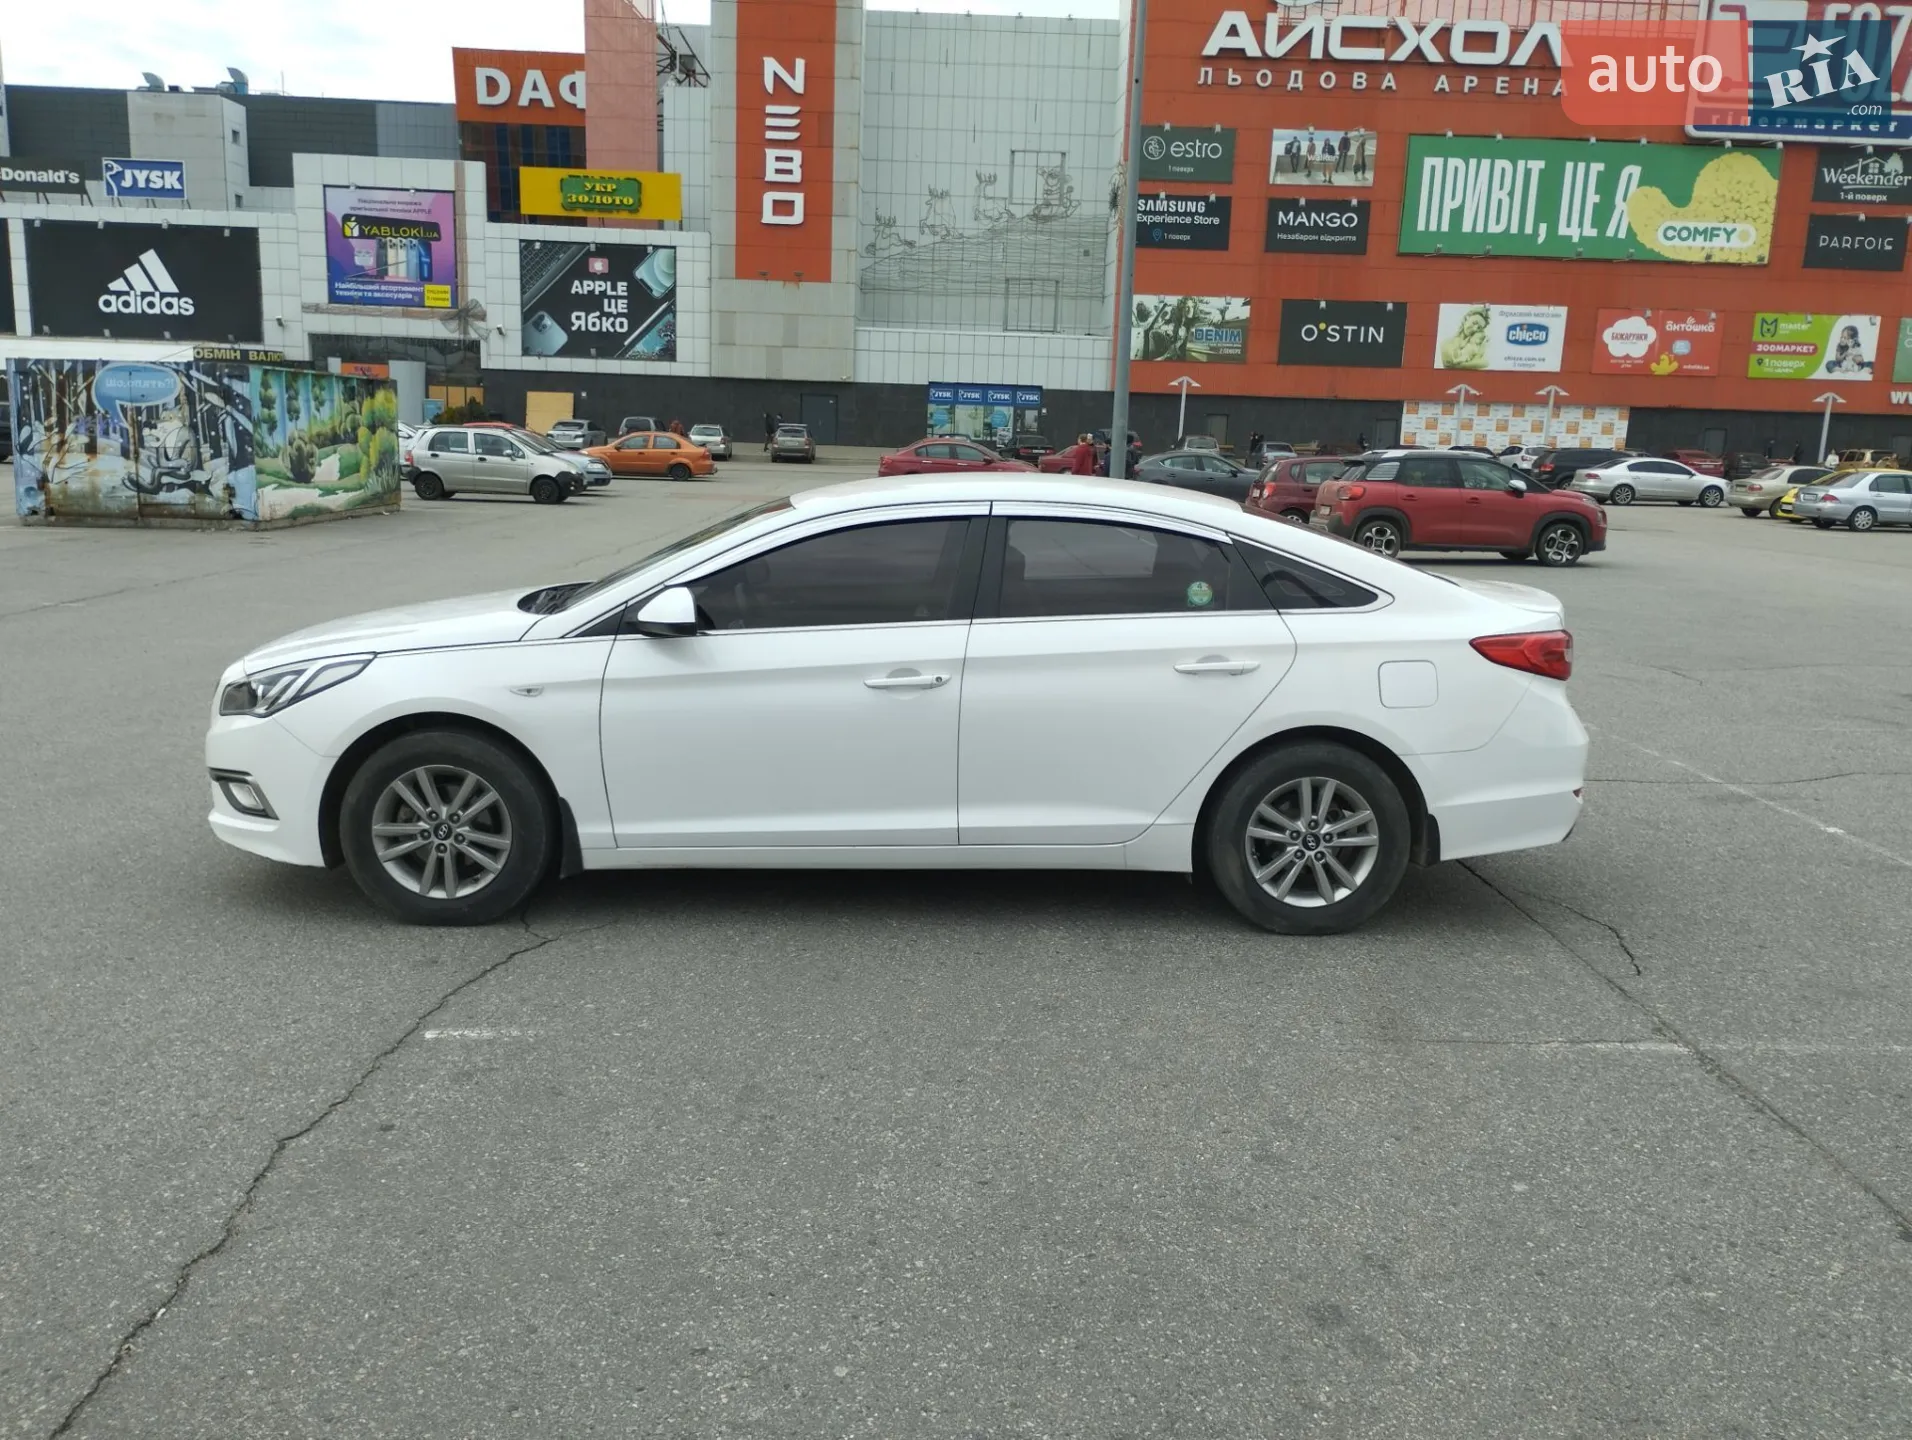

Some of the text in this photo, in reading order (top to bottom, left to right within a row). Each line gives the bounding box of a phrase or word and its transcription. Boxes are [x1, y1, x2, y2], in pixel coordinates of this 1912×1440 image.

[1197, 66, 1568, 97] ЛЬОДОВА АРЕНА
[760, 56, 806, 225] NEBO
[1170, 139, 1223, 159] estro
[0, 167, 80, 184] Donald's
[121, 169, 183, 190] JYSK
[1821, 163, 1912, 186] Weekender
[583, 181, 617, 192] УКР
[567, 192, 635, 206] ЗОЛОТО
[1137, 199, 1206, 213] SAMSUNG
[1416, 156, 1642, 245] ПРИВІТ, ЦЕ Я
[1855, 194, 1888, 203] поверх
[1136, 214, 1220, 225] Experience Store
[1277, 210, 1358, 228] MANGO
[1277, 232, 1357, 242] Незабаром відкриття
[1662, 225, 1737, 243] COMFY
[1819, 235, 1894, 250] PARFOIS
[571, 280, 629, 296] APPLE
[98, 290, 195, 316] adidas
[603, 298, 628, 314] ЦЕ
[1194, 328, 1242, 342] DENIM
[1508, 325, 1546, 342] chicco
[194, 348, 241, 360] ОБМІН
[1756, 343, 1815, 353] ЗООМАРКЕТ
[963, 391, 981, 399] JYSK
[993, 392, 1010, 400] JYSK
[1022, 393, 1039, 401] JYSK
